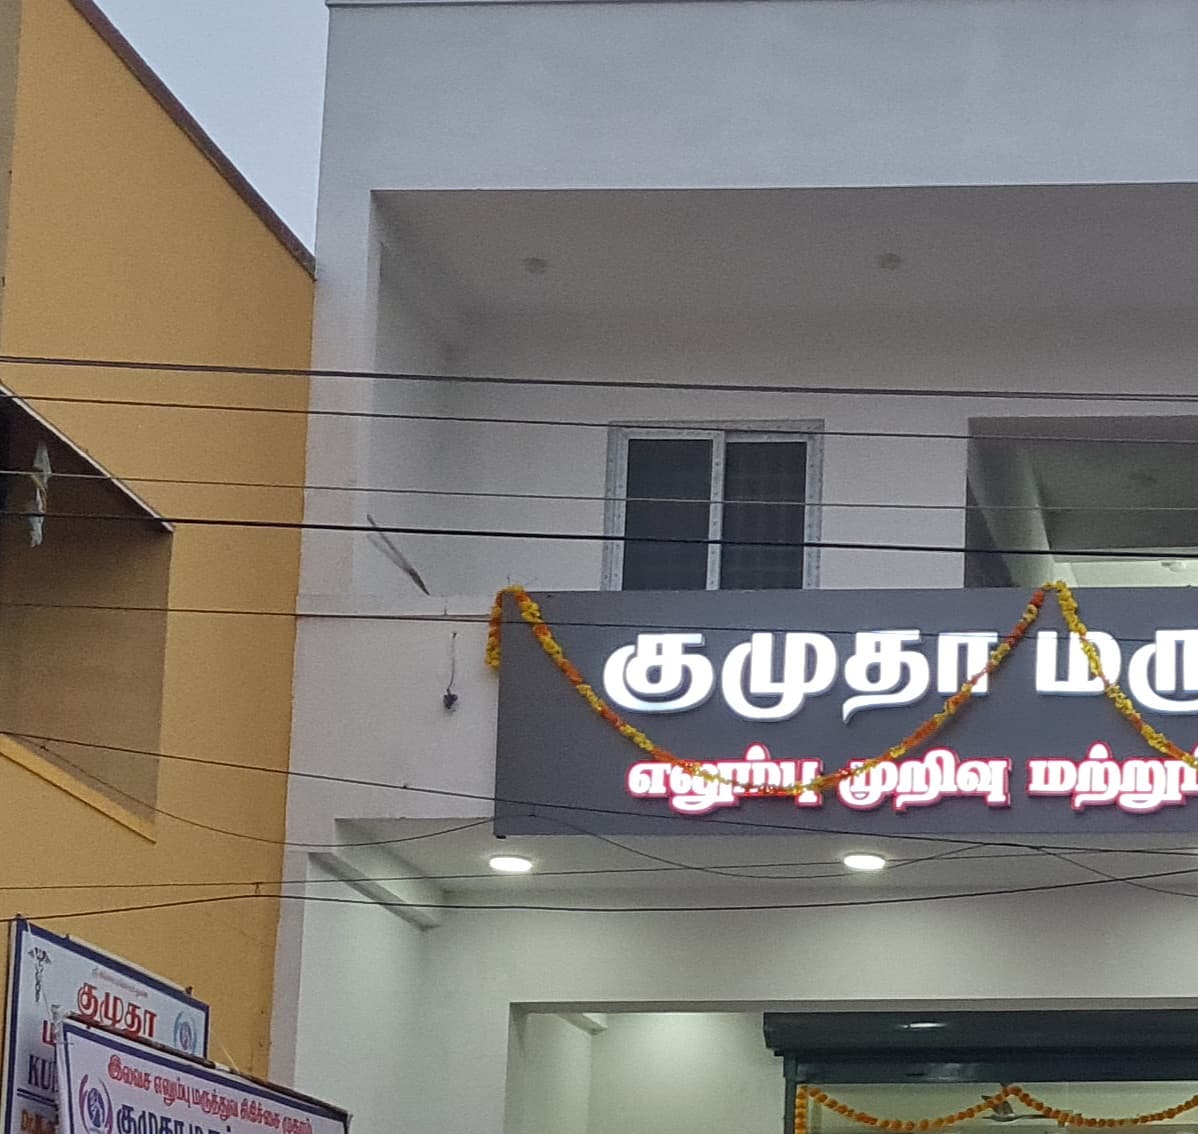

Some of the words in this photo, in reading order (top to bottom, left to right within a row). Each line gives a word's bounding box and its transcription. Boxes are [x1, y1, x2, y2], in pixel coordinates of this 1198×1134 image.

[603, 629, 997, 722] குமுதா
[626, 741, 824, 815] எலும்பு
[836, 746, 1013, 813] முறிவு
